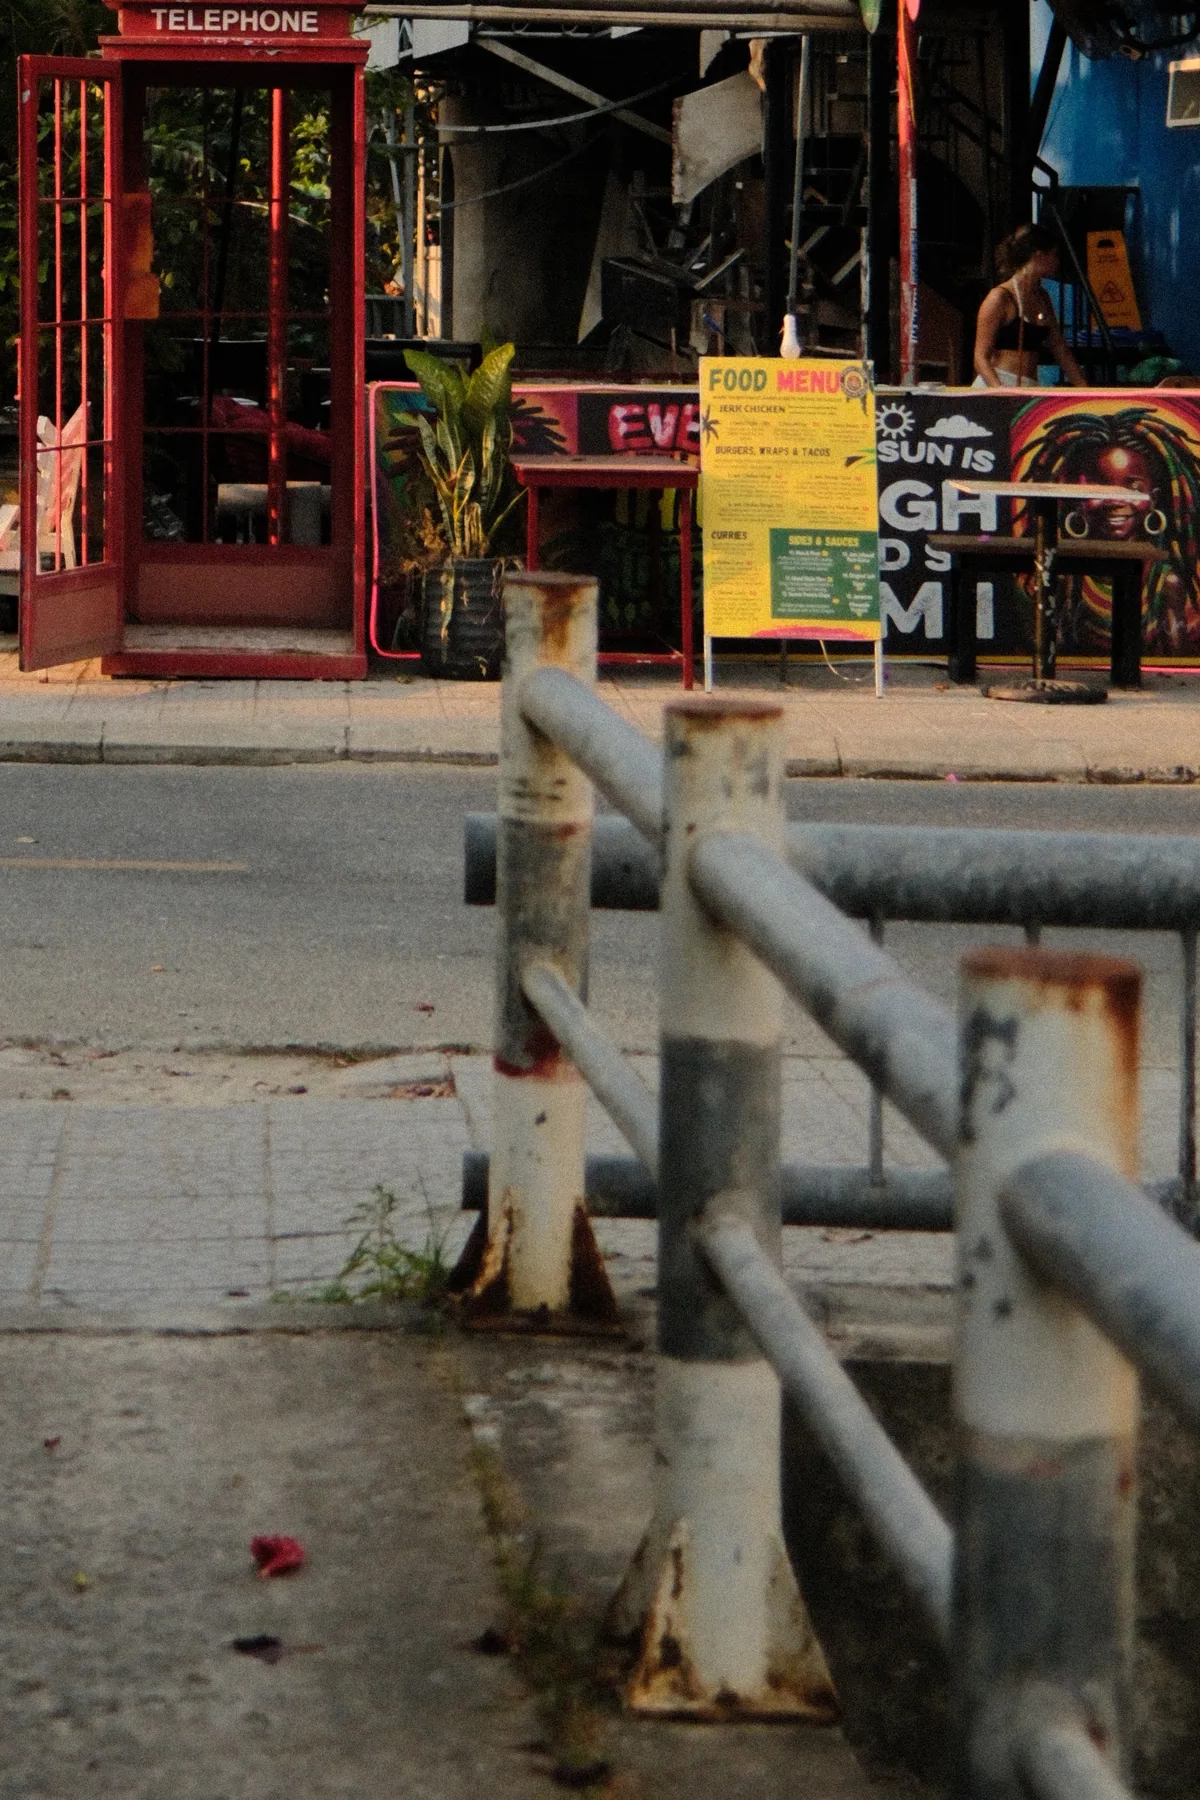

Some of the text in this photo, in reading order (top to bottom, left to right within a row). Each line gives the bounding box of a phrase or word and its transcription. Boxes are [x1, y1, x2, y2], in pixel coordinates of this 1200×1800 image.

[151, 9, 319, 32] TELEPHONE
[709, 369, 767, 391] FOOD
[777, 370, 840, 393] MENU
[719, 404, 742, 413] JERK
[744, 404, 785, 414] CHICKEN
[758, 447, 789, 456] WRAPS
[802, 448, 830, 457] TACOS
[878, 440, 996, 473] SUN IS
[711, 530, 748, 540] CURRIES
